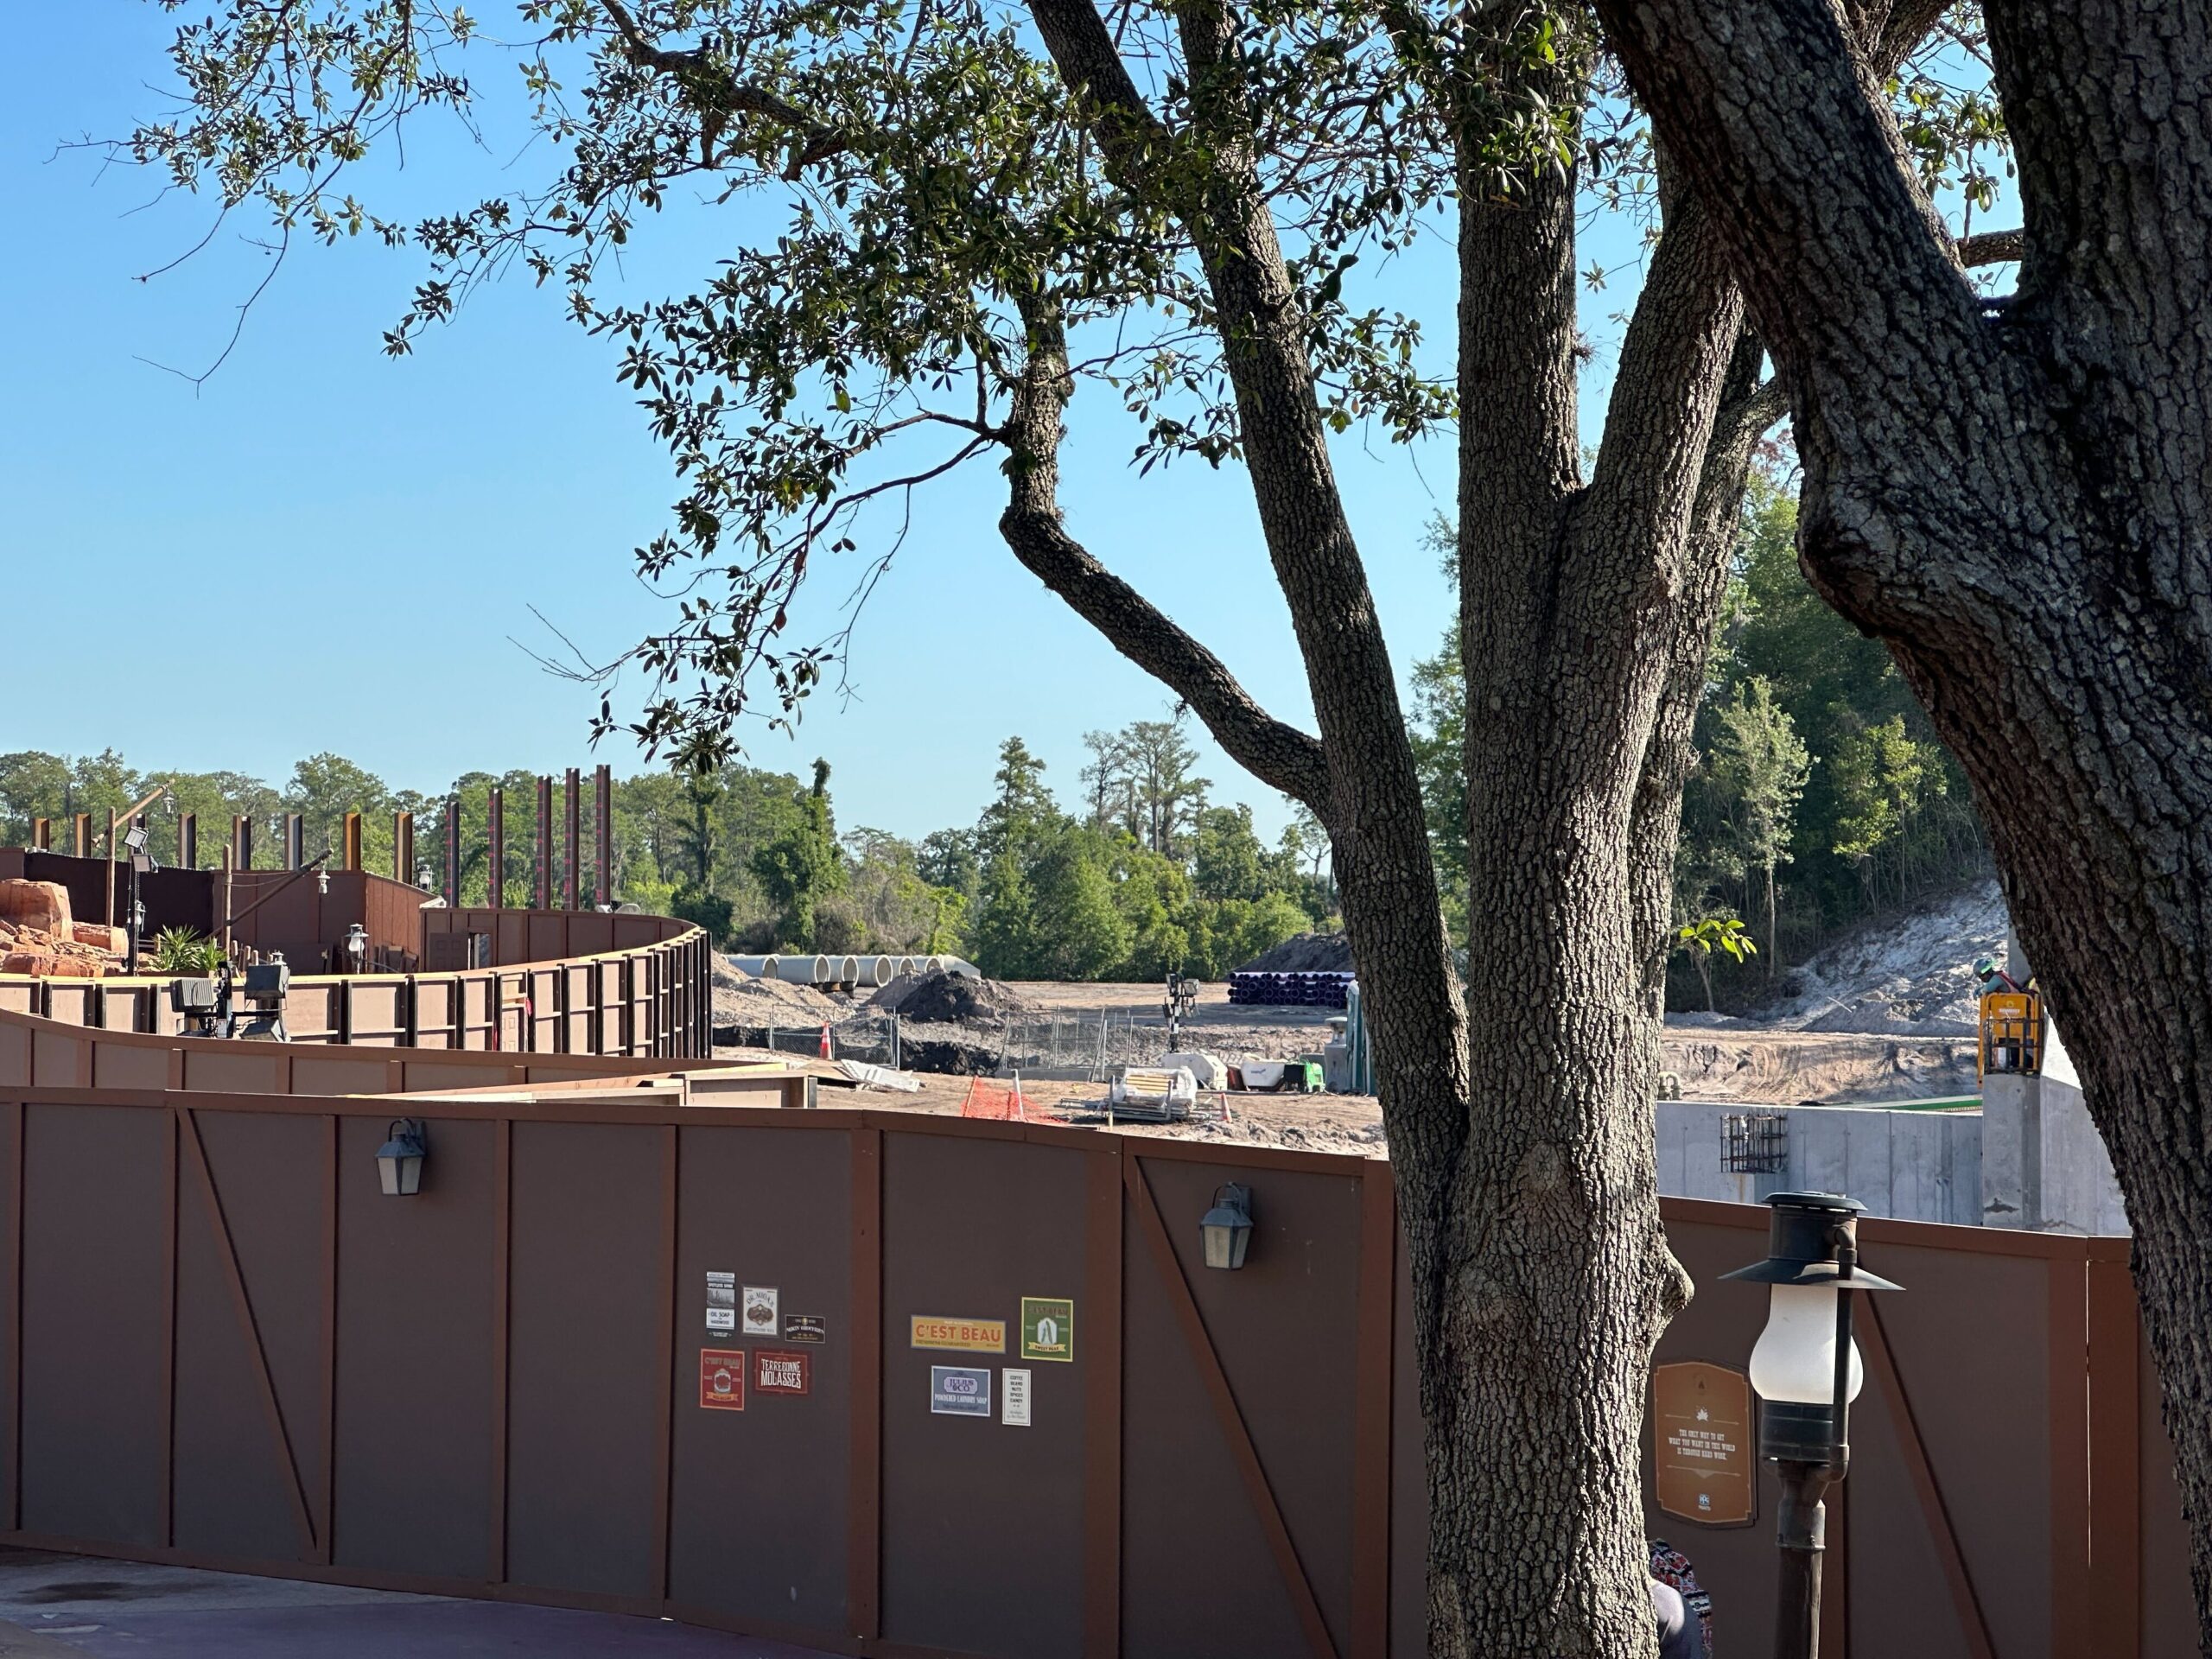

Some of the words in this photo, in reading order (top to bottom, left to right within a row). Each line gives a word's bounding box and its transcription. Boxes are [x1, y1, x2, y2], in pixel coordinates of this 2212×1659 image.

[916, 1325, 957, 1339] C'EST
[961, 1327, 1001, 1342] BEAU
[760, 1370, 802, 1389] MOLASSES
[949, 1378, 974, 1387] JULIUS
